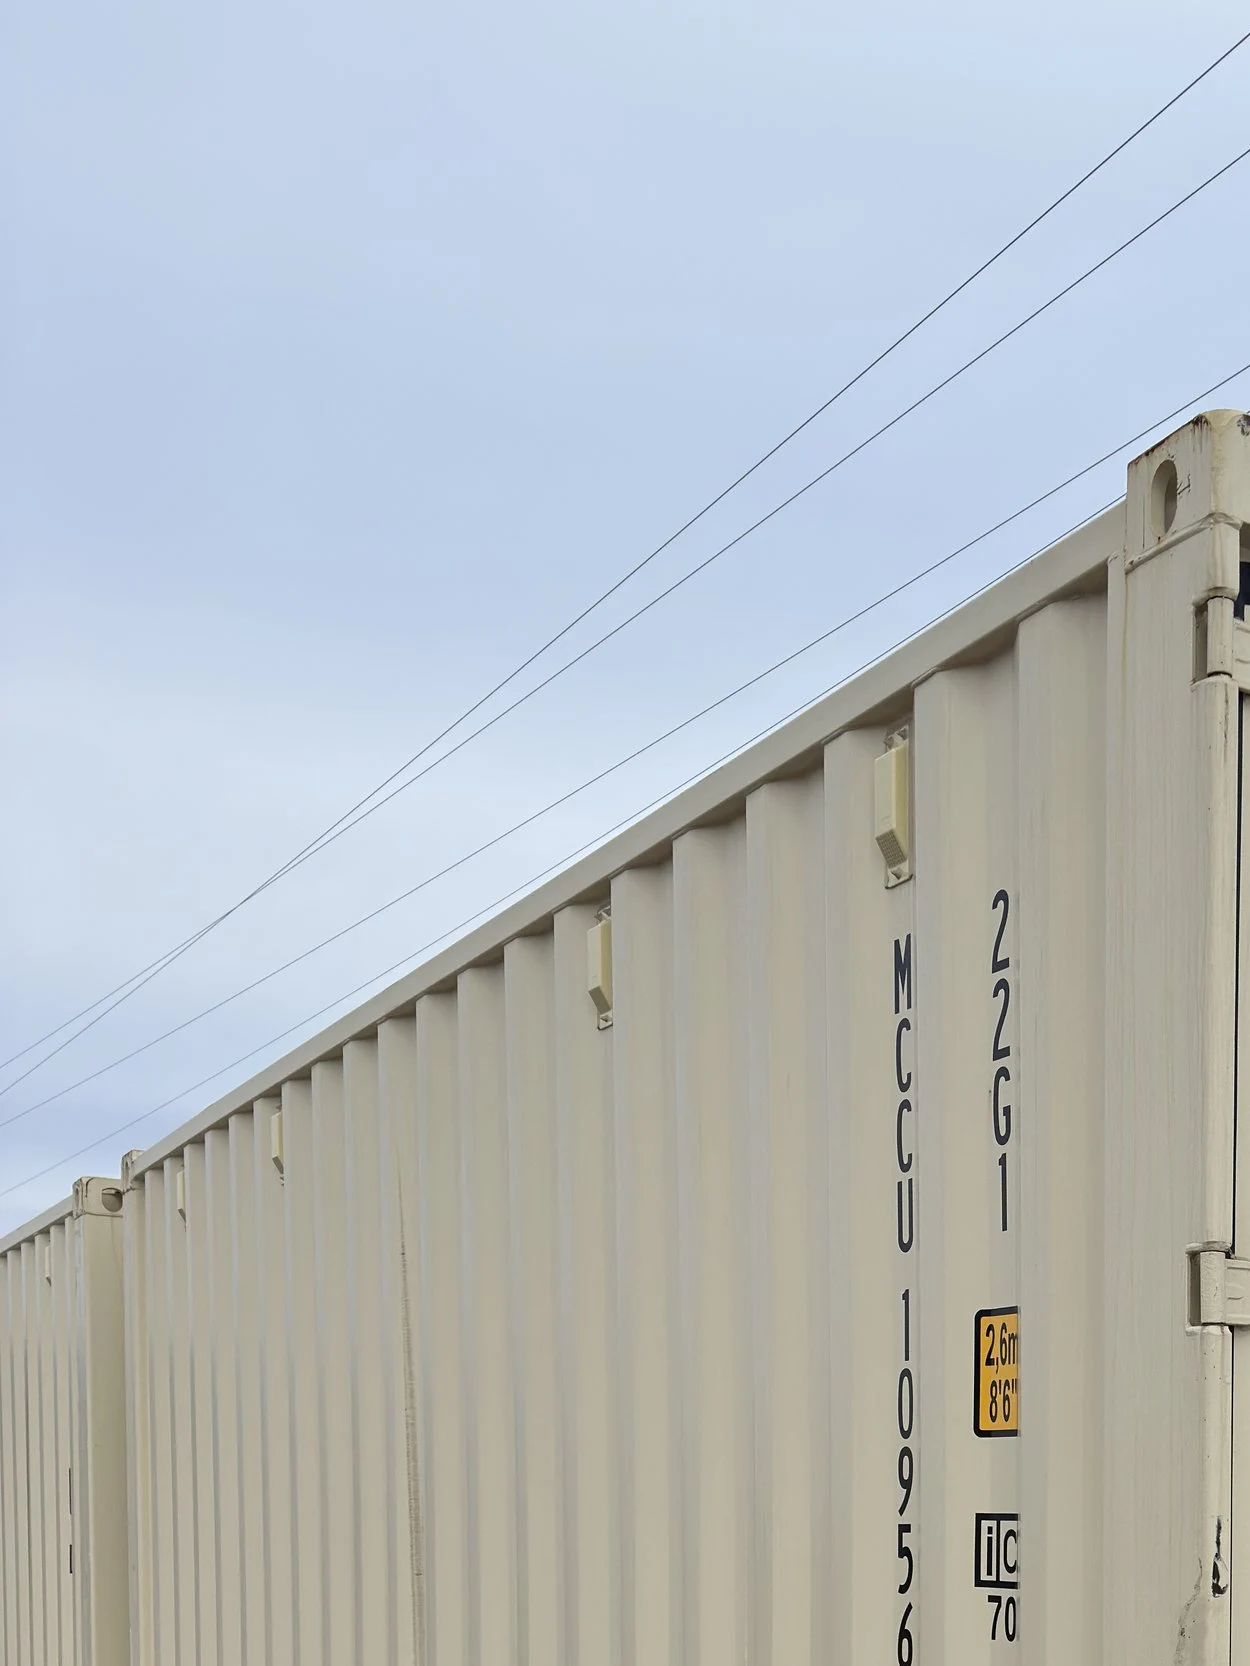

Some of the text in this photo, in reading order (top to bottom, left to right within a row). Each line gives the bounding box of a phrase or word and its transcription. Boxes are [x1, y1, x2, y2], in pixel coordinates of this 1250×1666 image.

[894, 934, 913, 1253] MCCU
[992, 890, 1011, 1231] 22G1
[987, 1594, 1017, 1642] 70
